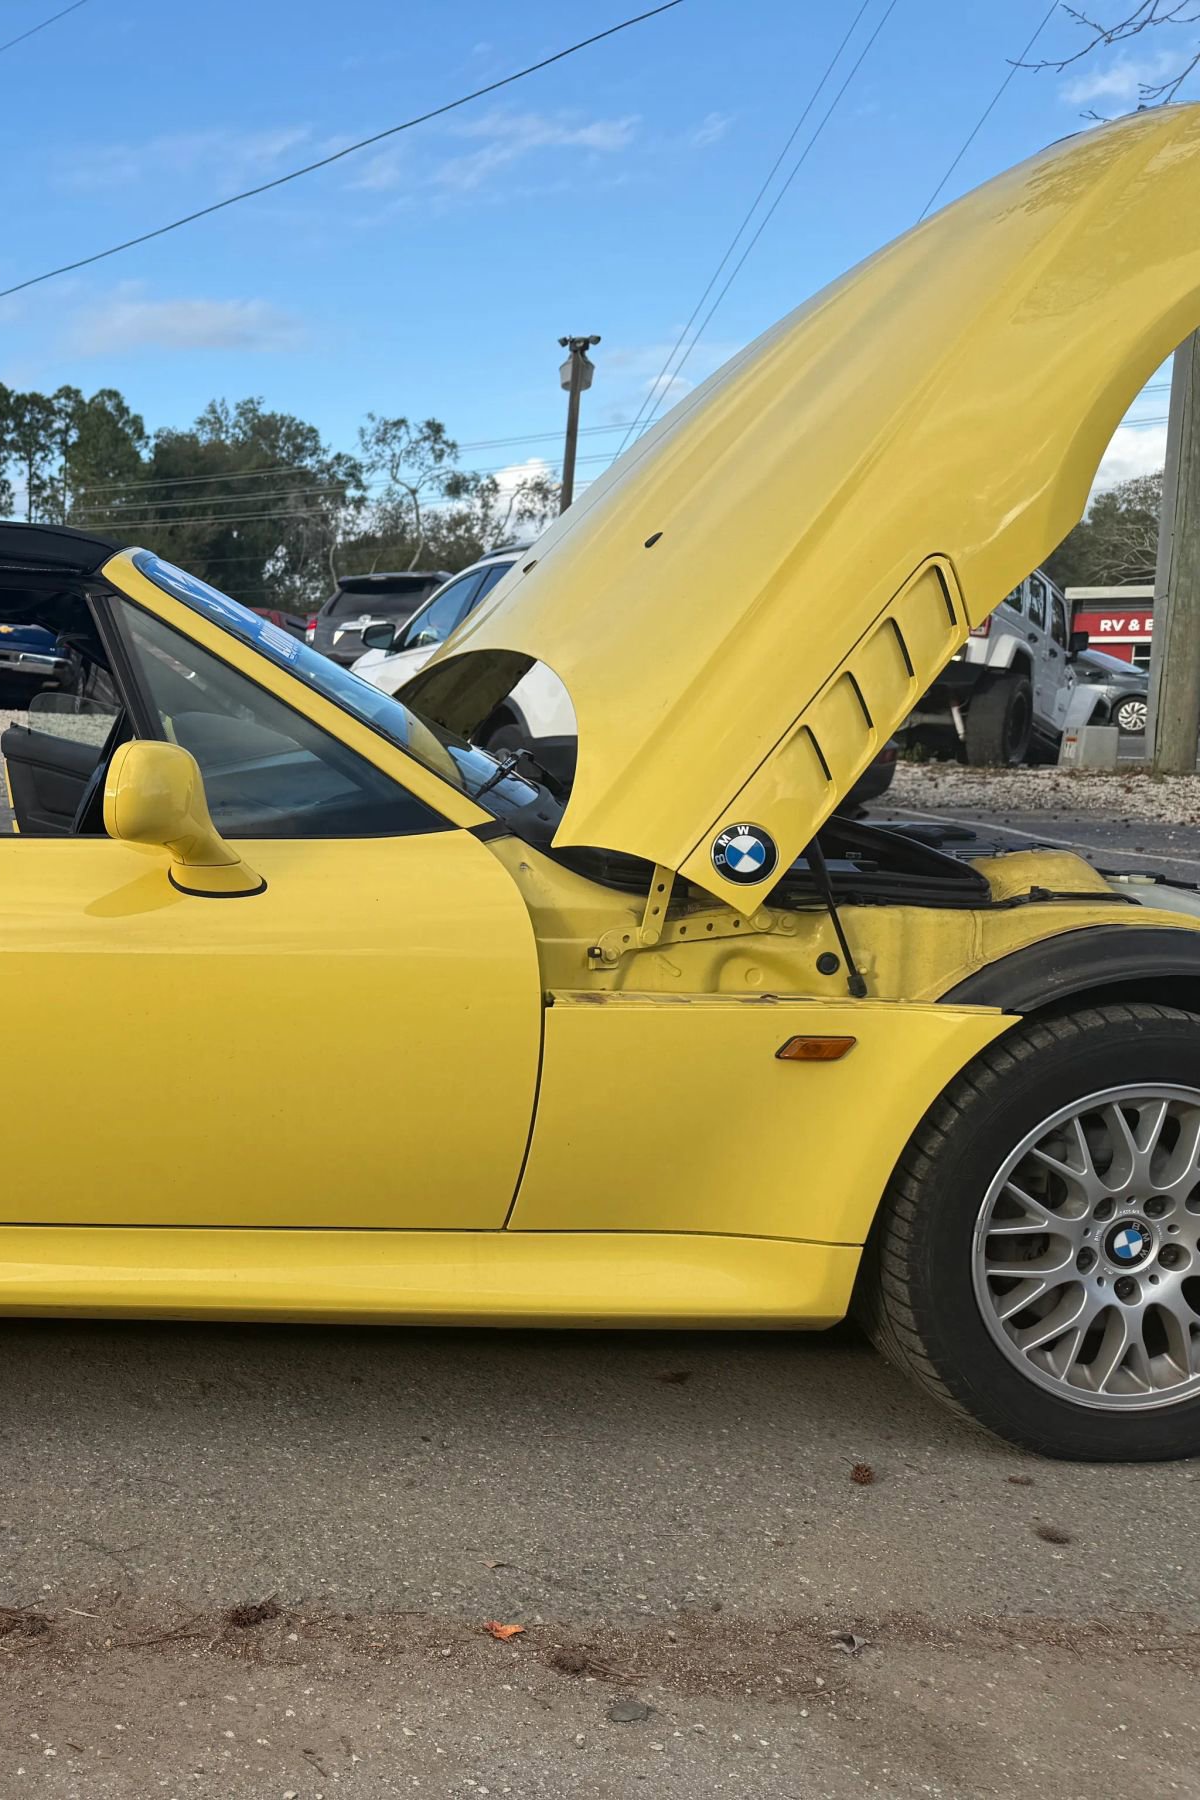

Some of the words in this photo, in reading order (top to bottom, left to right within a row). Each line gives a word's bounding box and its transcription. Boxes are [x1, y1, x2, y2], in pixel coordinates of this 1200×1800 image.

[1100, 619, 1125, 632] RV
[1128, 618, 1140, 631] &
[715, 826, 749, 865] BMW
[1132, 1222, 1150, 1258] BMW
